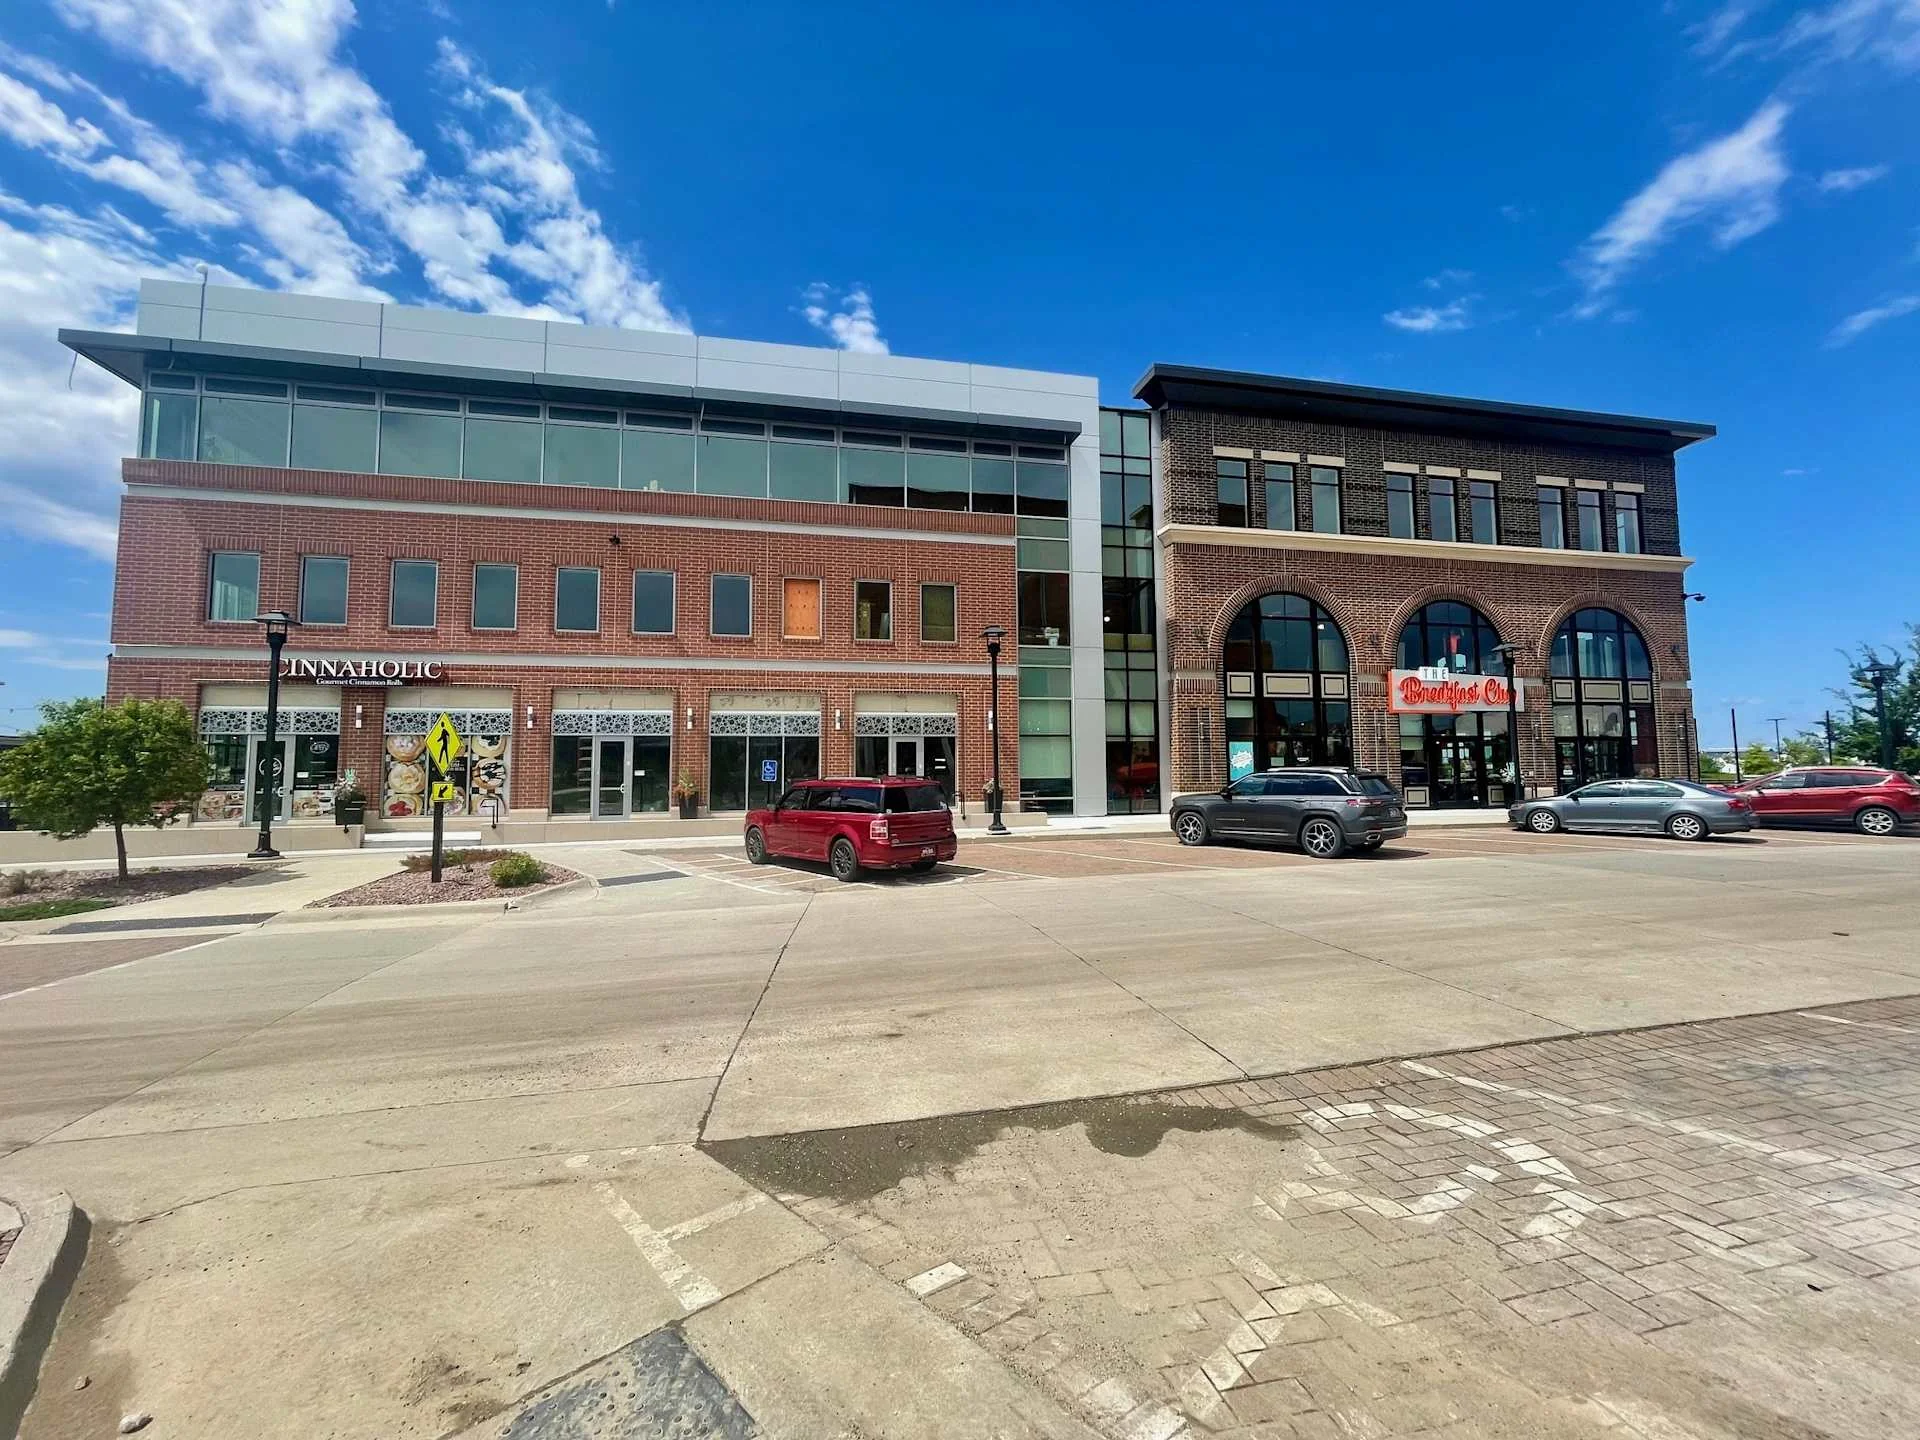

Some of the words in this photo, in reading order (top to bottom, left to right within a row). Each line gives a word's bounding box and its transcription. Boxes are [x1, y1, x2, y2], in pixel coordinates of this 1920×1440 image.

[1423, 668, 1447, 680] THE
[1400, 676, 1480, 710] Breakfast
[1485, 678, 1518, 706] Clu
